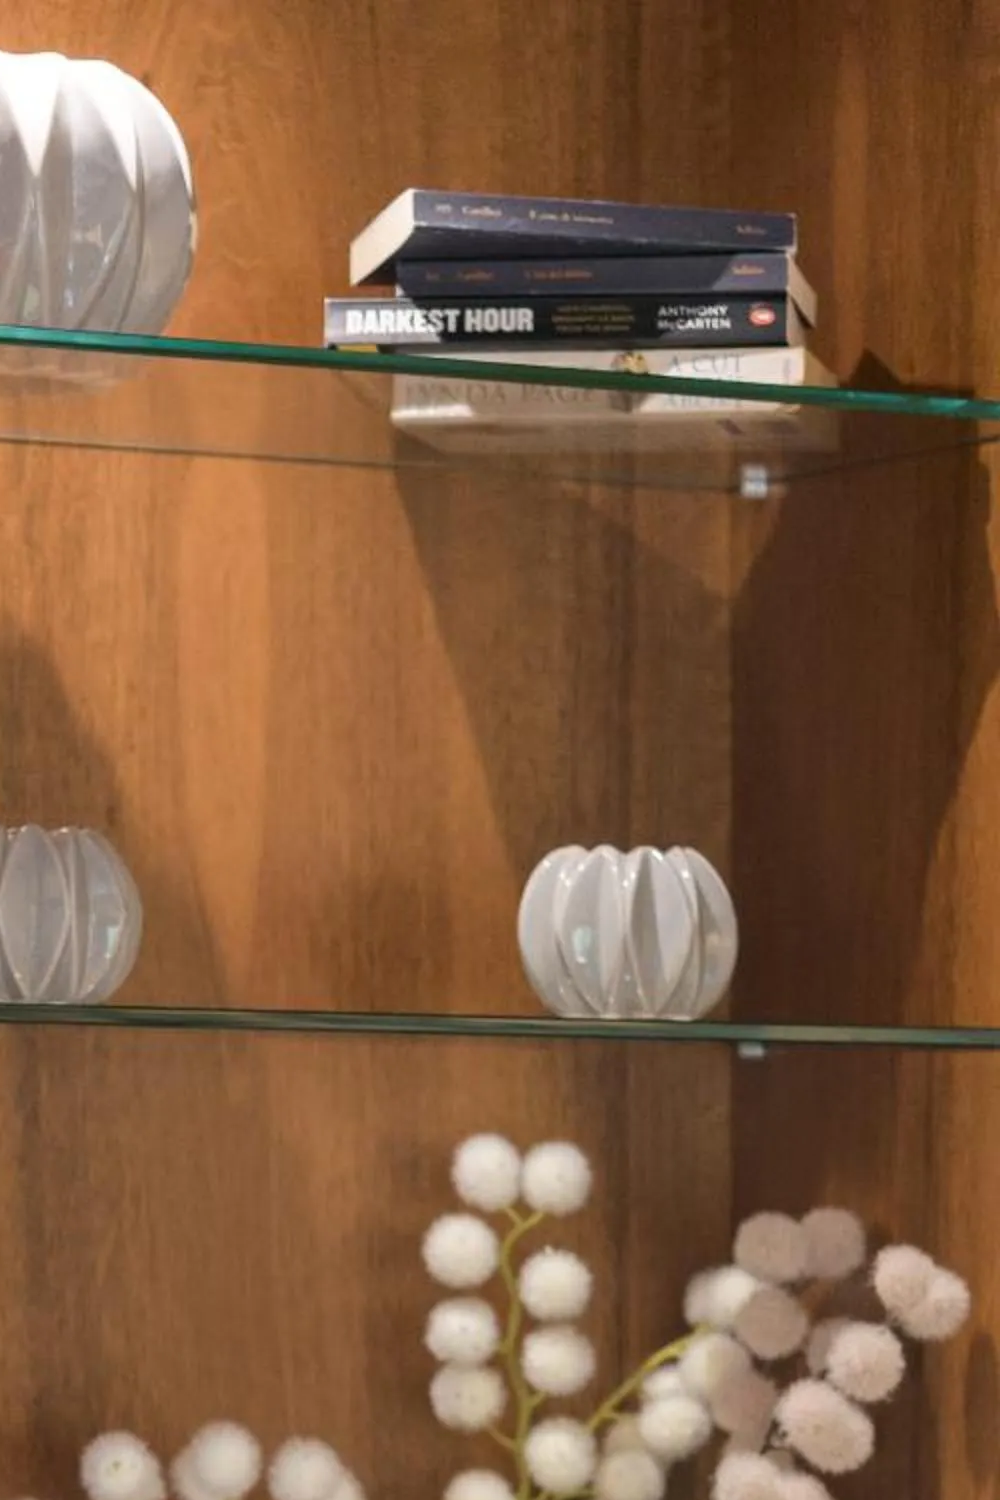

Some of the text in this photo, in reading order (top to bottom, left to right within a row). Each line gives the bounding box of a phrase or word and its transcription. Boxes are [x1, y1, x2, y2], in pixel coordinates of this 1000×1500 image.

[656, 304, 729, 318] ANTHONY
[345, 308, 535, 335] DARKEST HOUR
